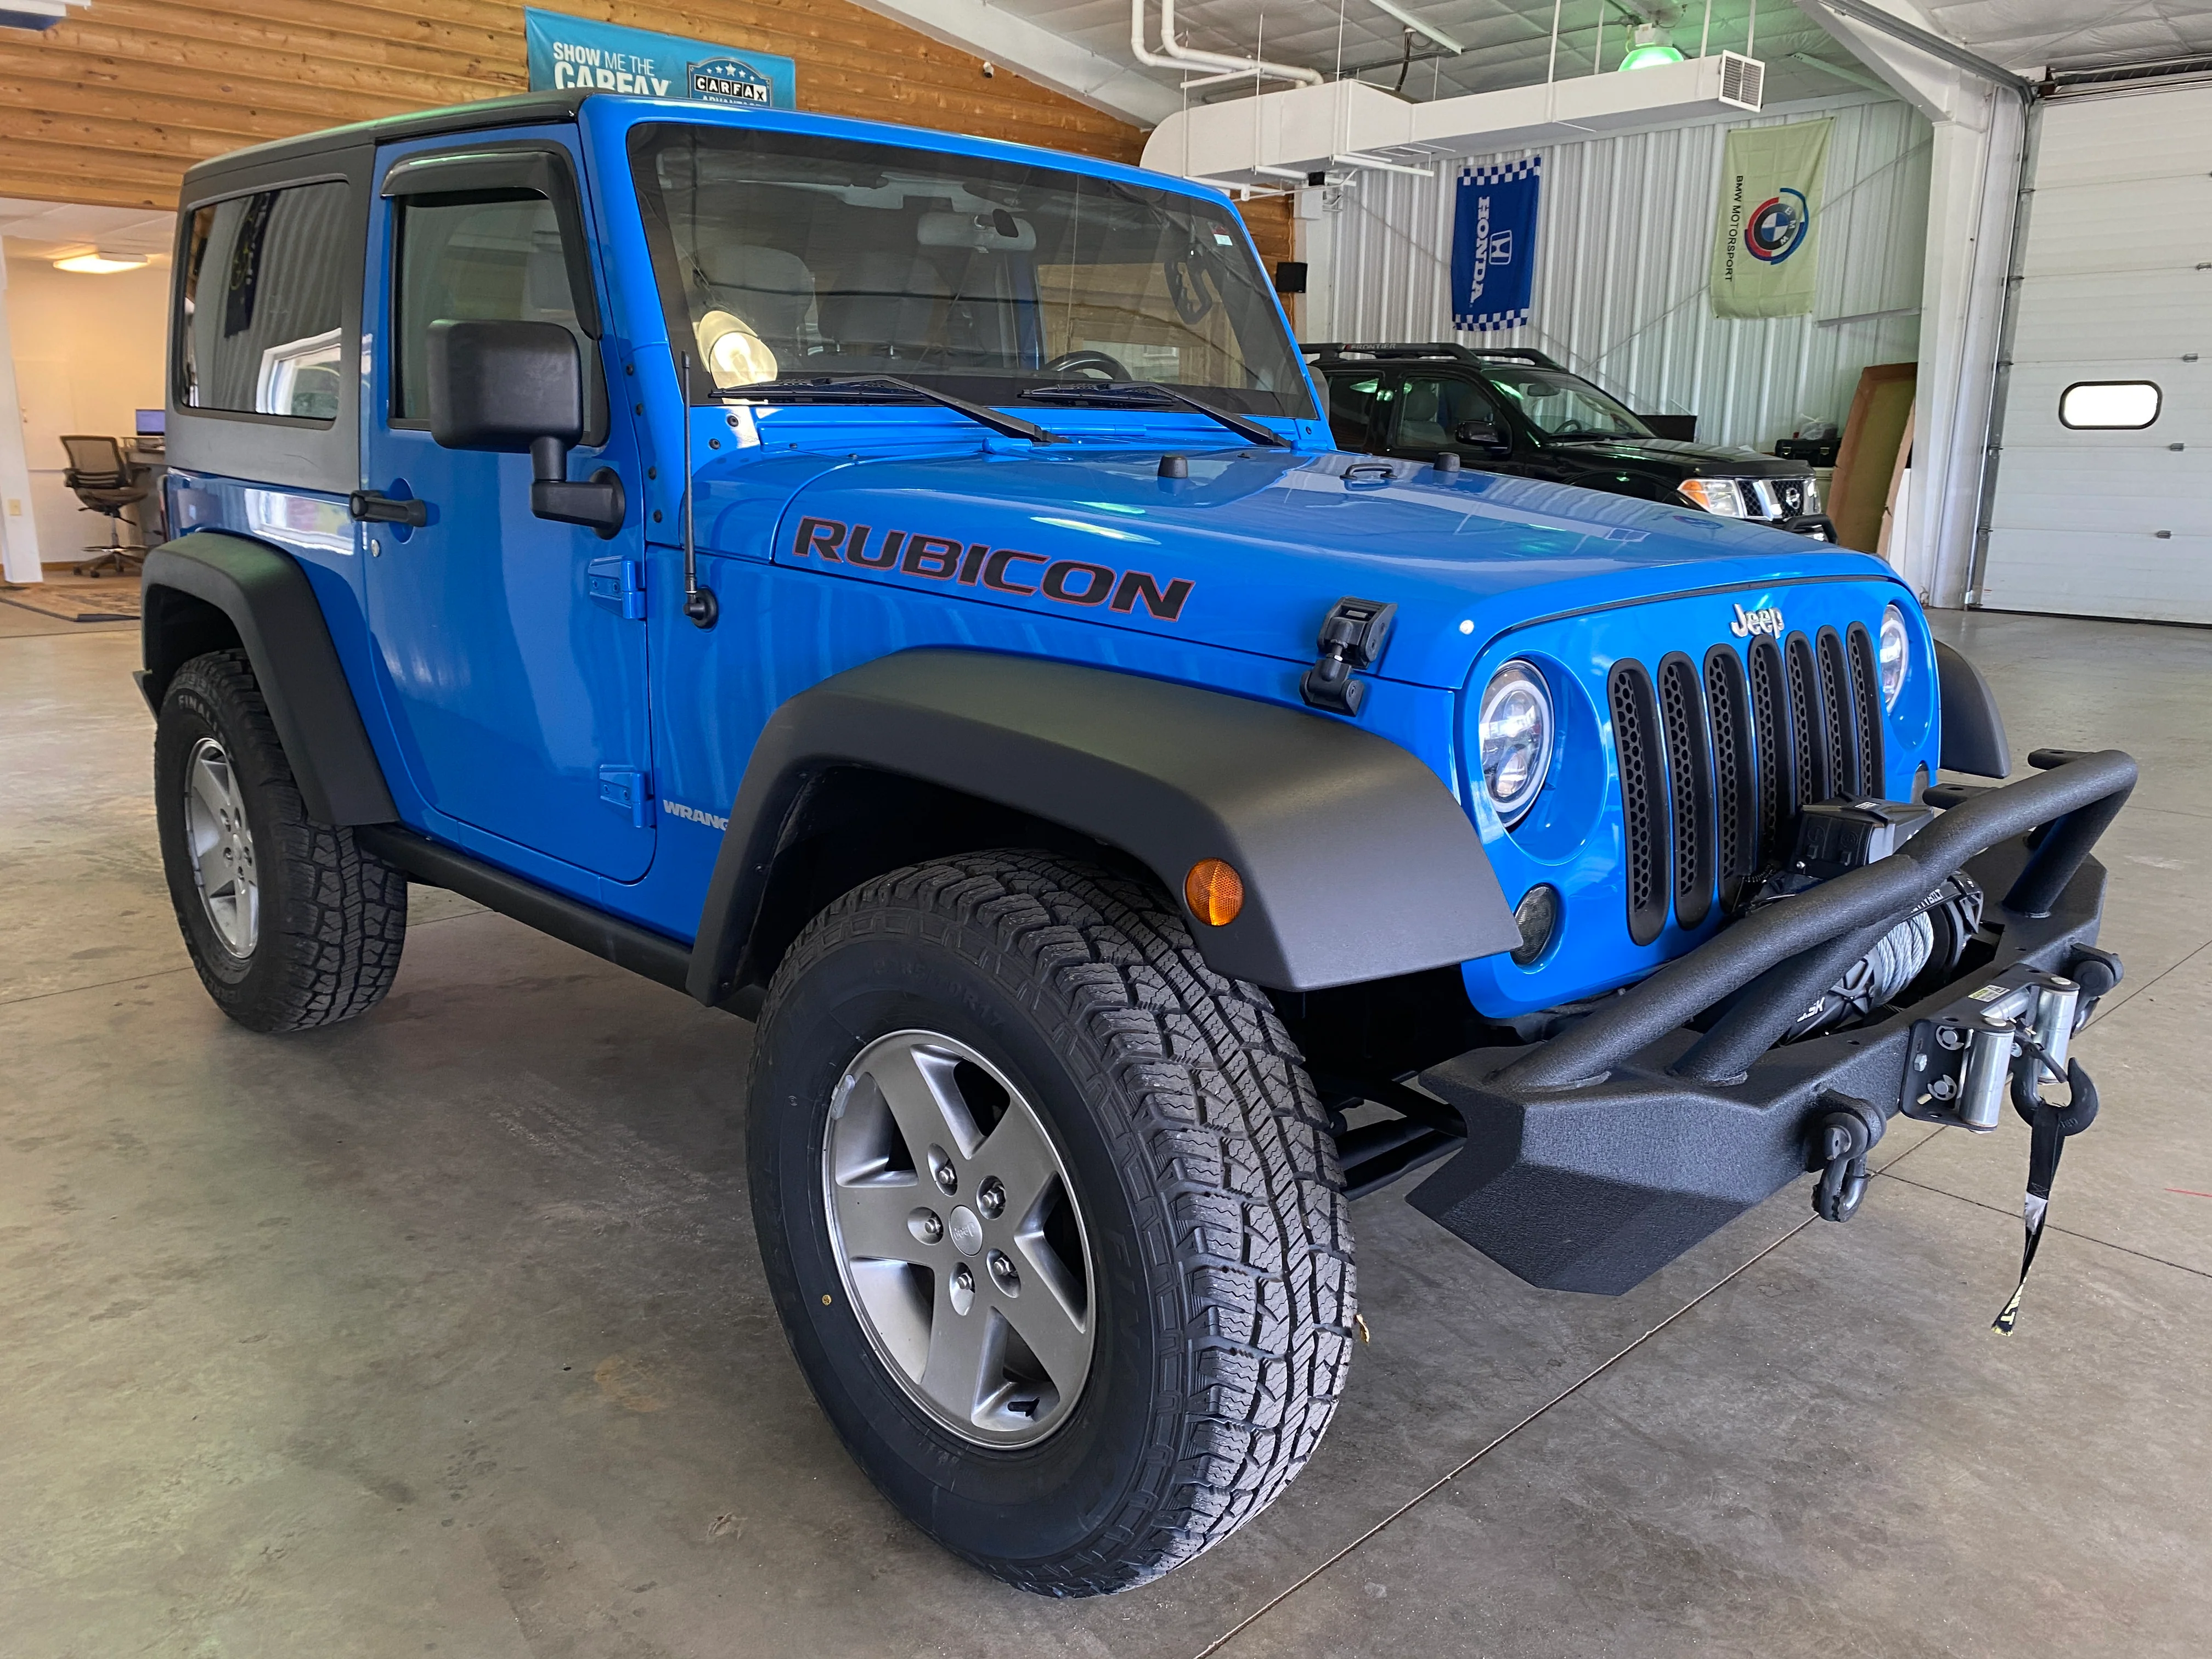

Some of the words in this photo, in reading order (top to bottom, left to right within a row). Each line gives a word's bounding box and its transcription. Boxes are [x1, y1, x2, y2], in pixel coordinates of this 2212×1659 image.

[552, 41, 601, 67] SHOW
[604, 50, 627, 72] ME
[629, 55, 655, 77] THE
[696, 77, 764, 101] CARFAX
[1734, 176, 1743, 202] BMW
[1471, 196, 1490, 303] HONDA
[1725, 206, 1741, 281] MOTORSPORT
[792, 516, 1197, 622] RUBICON
[1729, 603, 1785, 640] Jeep
